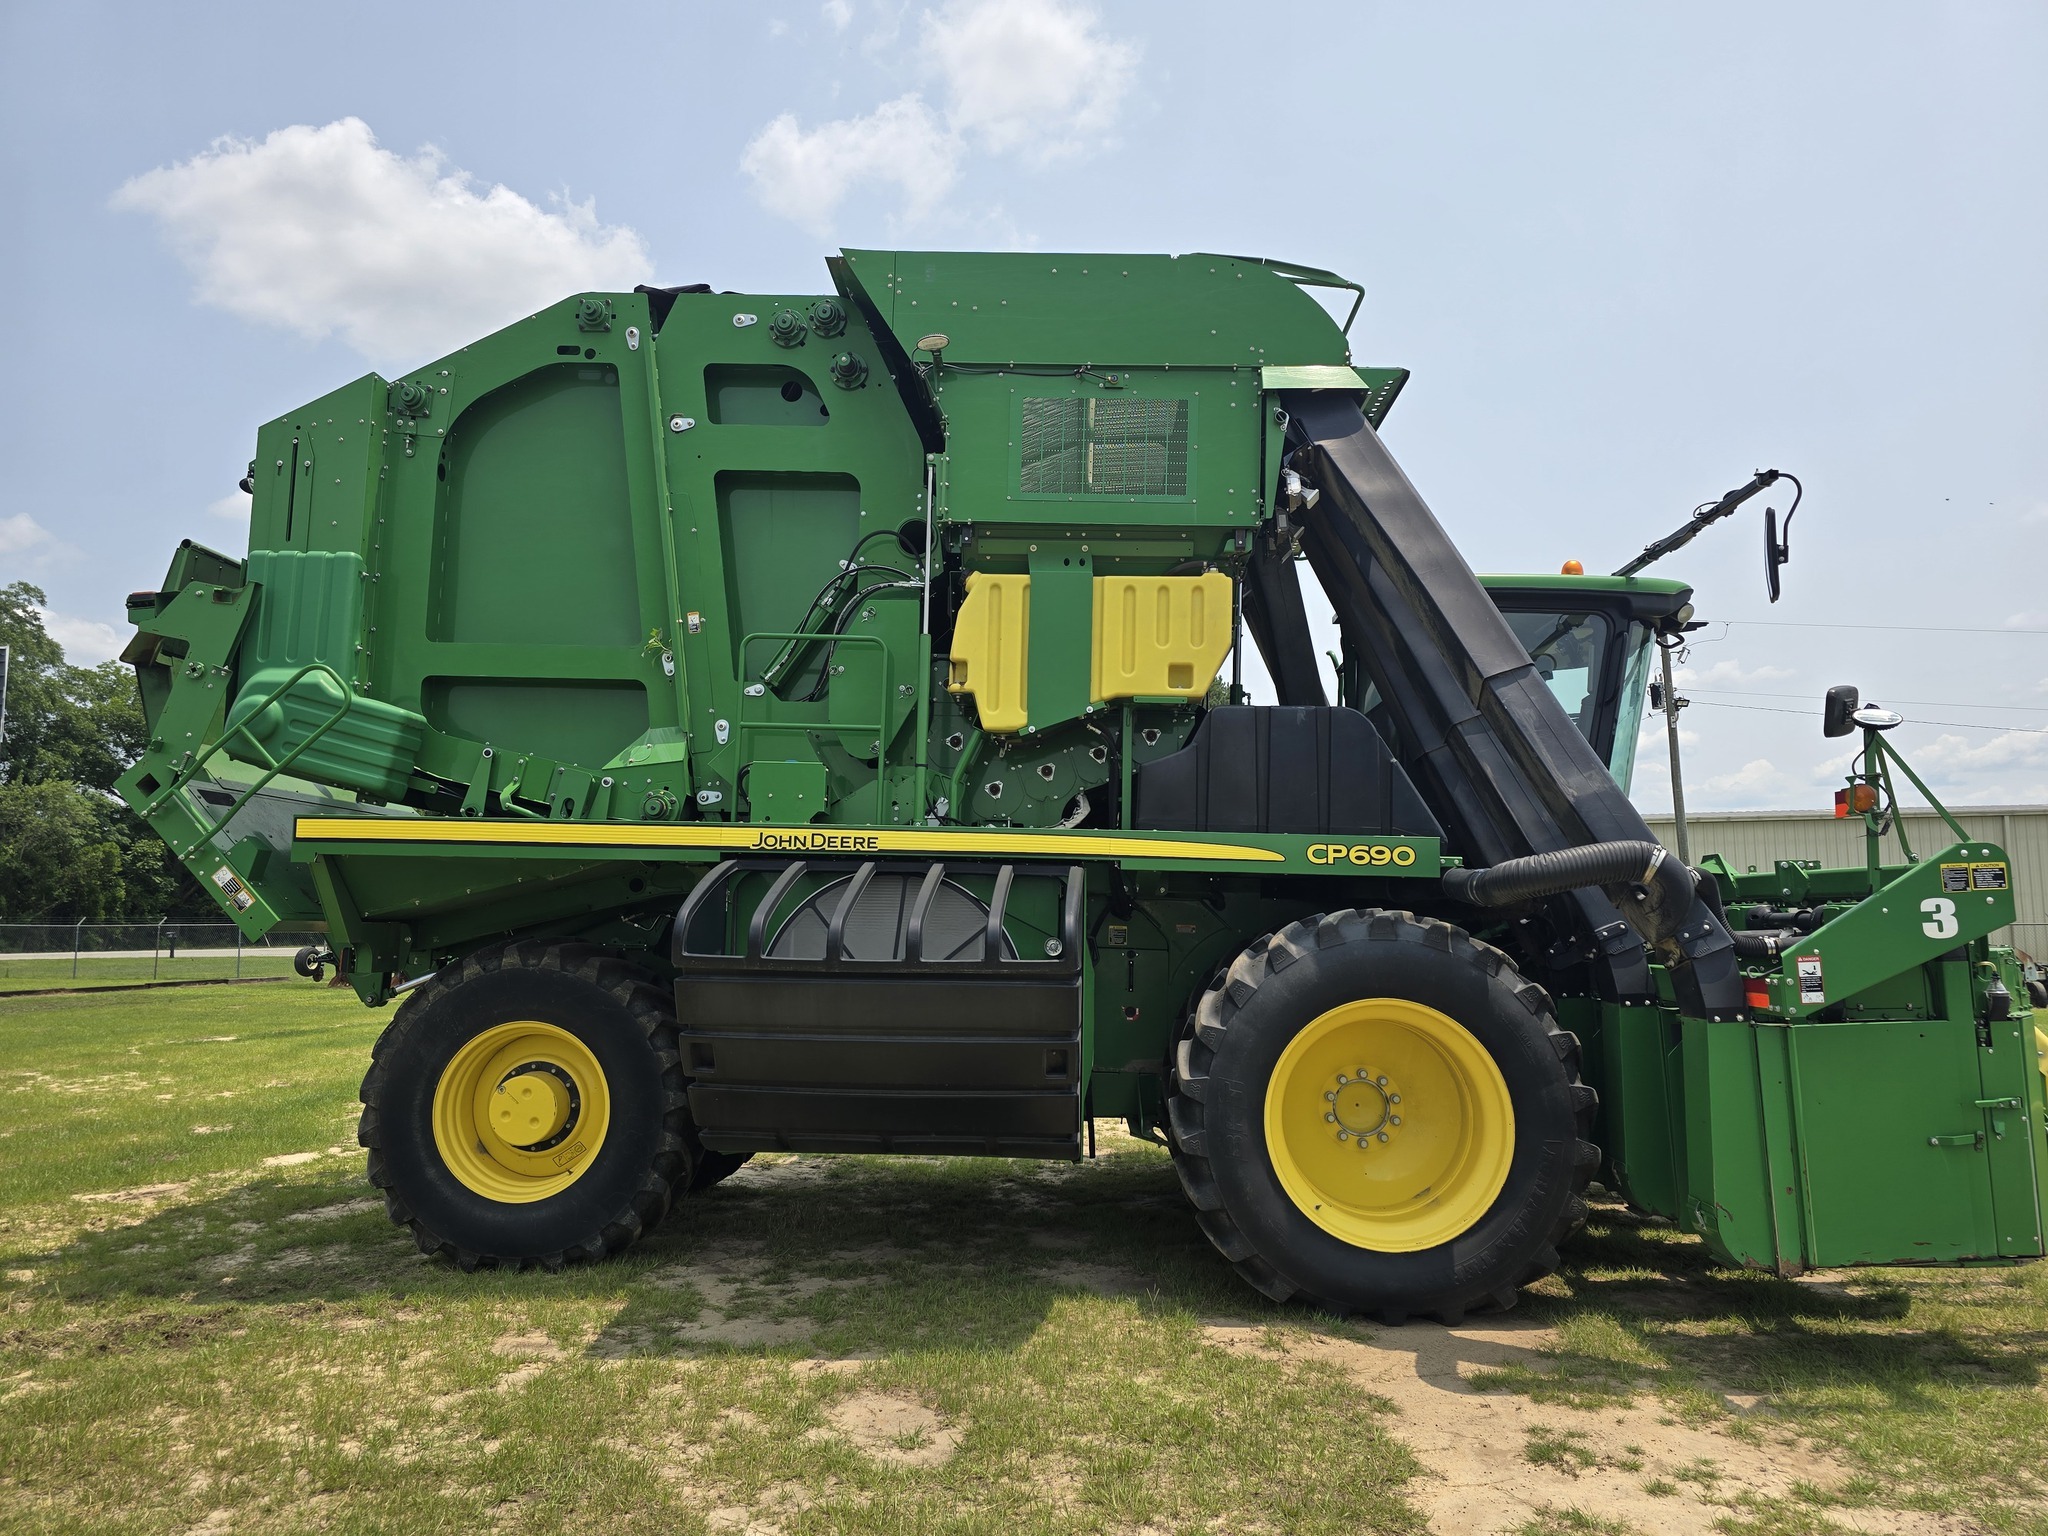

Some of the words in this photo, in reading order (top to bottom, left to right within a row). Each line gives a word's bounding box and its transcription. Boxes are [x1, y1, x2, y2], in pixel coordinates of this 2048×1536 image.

[752, 832, 807, 849] JOHN
[811, 833, 879, 849] DEERE
[1306, 843, 1416, 867] CP690
[1920, 897, 1959, 939] 3
